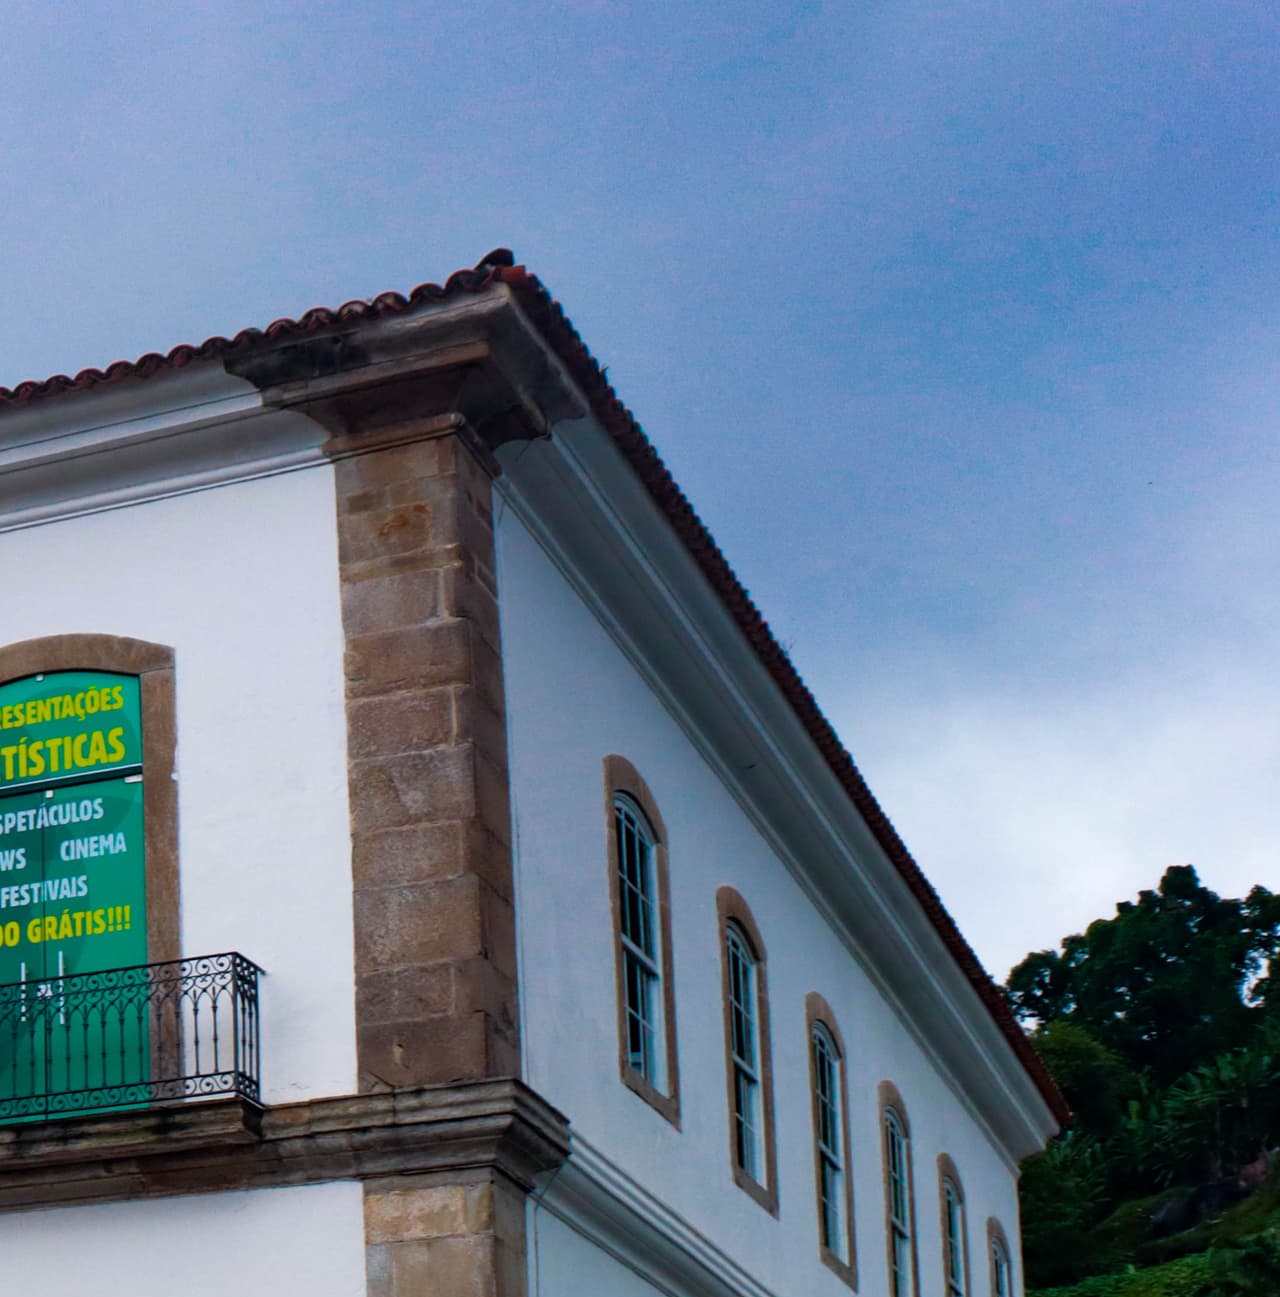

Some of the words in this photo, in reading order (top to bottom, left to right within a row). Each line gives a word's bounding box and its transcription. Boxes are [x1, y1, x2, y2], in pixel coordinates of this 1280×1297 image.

[60, 832, 127, 861] CINEMA
[0, 875, 88, 908] FESTIVAIS
[27, 905, 131, 943] GRÁTIS!!!
